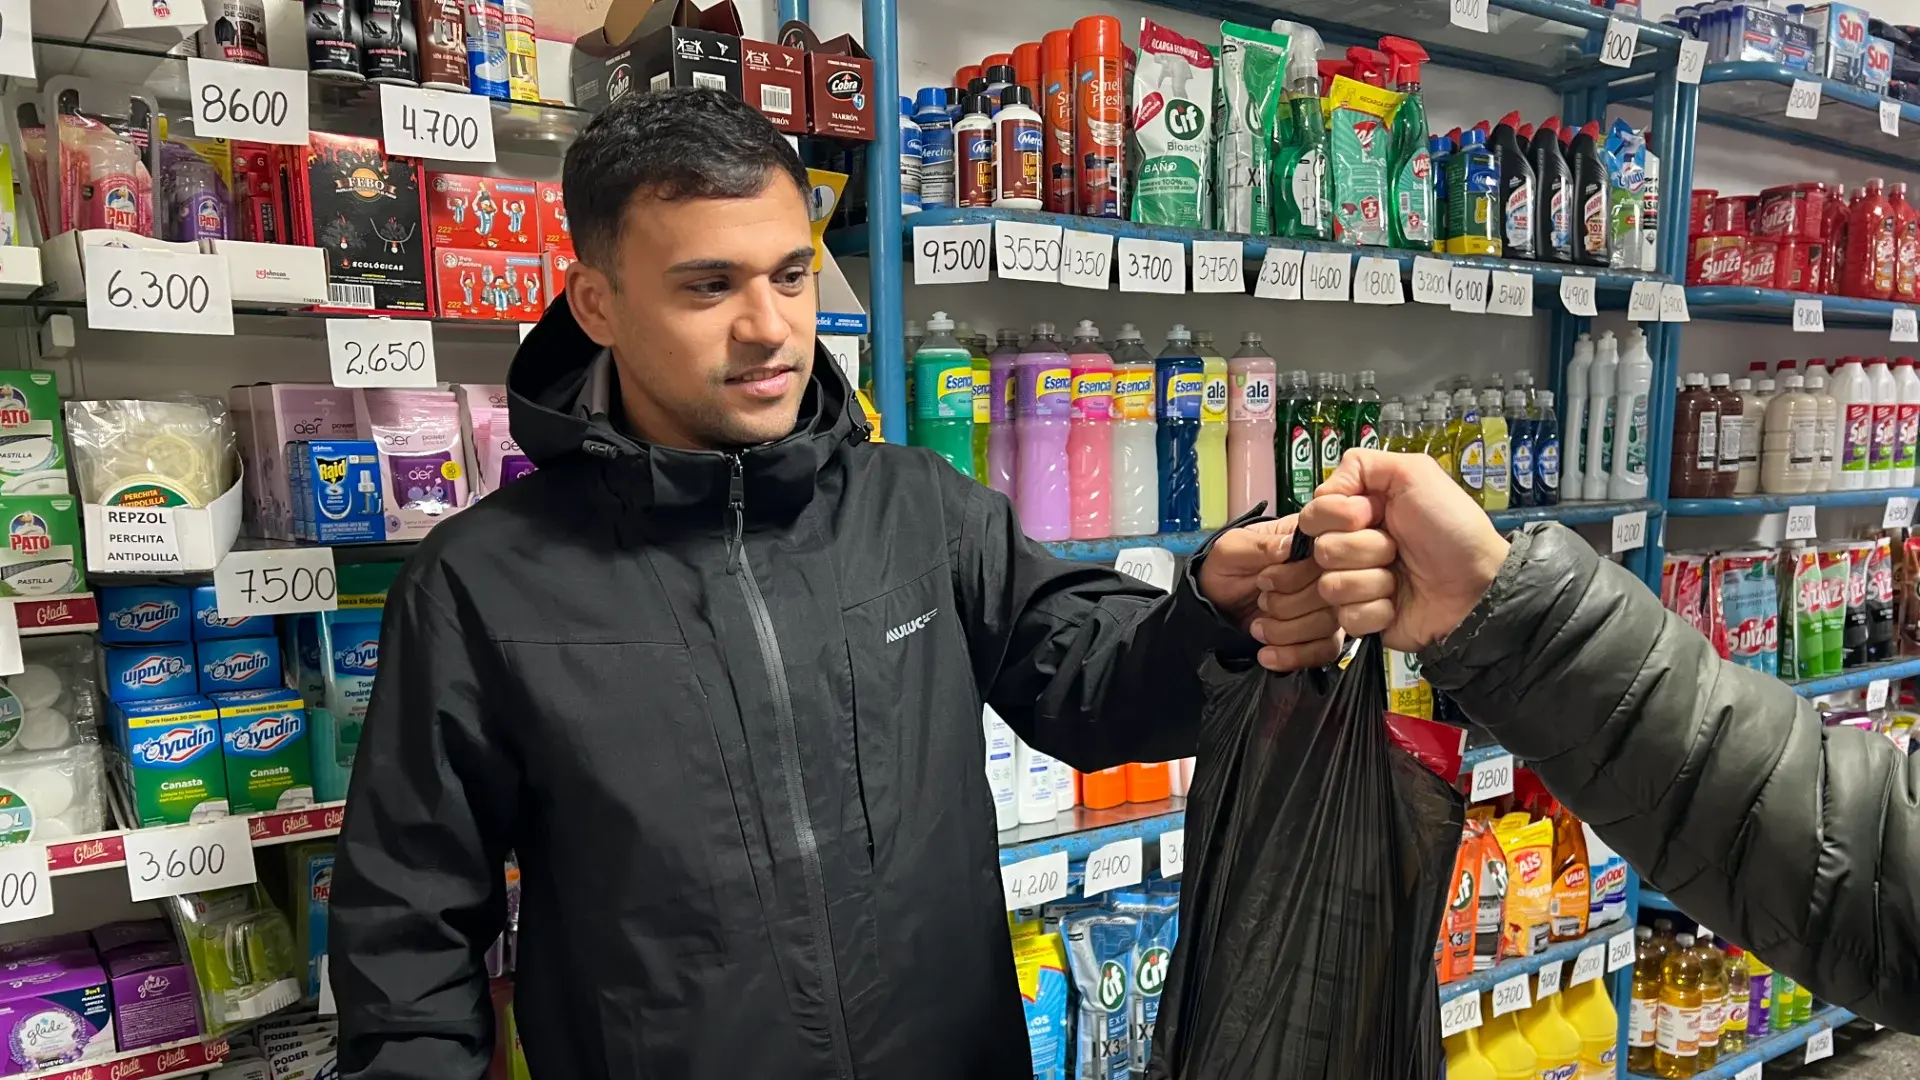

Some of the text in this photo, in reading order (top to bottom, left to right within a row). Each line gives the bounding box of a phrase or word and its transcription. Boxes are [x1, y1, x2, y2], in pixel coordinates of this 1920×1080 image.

[1838, 14, 1864, 42] Sun
[1867, 45, 1890, 71] Sun
[831, 79, 858, 91] Cobra
[402, 104, 478, 149] 4.700
[831, 112, 858, 121] MARRÓN
[1169, 104, 1198, 134] Cif
[1144, 160, 1177, 173] BAÑO
[348, 176, 384, 190] FEBO
[923, 239, 986, 274] 9.500
[1002, 234, 1062, 271] 3.550
[352, 261, 404, 271] ECOLÓGICAS
[1128, 253, 1172, 282] 3.700
[1700, 252, 1742, 279] Suiza
[107, 269, 209, 314] 6.300
[345, 341, 425, 375] 2.650
[1207, 381, 1226, 399] ala
[1247, 381, 1269, 398] ala
[422, 434, 446, 442] power
[319, 459, 346, 480] Raid
[124, 490, 158, 501] PERCHITA
[108, 512, 167, 524] REPZOL
[11, 535, 50, 550] PATO
[109, 534, 164, 544] PERCHITA
[107, 552, 179, 562] ANTIPOLILLA
[235, 567, 335, 604] 7.500
[37, 602, 73, 625] Glade
[116, 601, 181, 630] Ayudín
[209, 653, 270, 682] Ayudín
[142, 724, 215, 763] Ayudín
[232, 715, 301, 751] Ayudín
[250, 766, 290, 778] Canasta
[160, 778, 203, 791] Canasta
[282, 815, 313, 835] Glade
[324, 812, 345, 831] Glad
[73, 842, 109, 864] Glade
[139, 843, 225, 882] 3.600
[1011, 870, 1059, 899] 4.200
[138, 977, 171, 999] glade
[27, 1019, 69, 1046] glade
[257, 1019, 291, 1030] PODER
[263, 1030, 299, 1042] PODER
[267, 1041, 303, 1053] PODER
[1102, 1039, 1121, 1058] X3
[39, 1059, 64, 1068] NUEVO
[110, 1057, 145, 1080] Glade
[157, 1048, 190, 1072] Glade
[204, 1039, 230, 1062] Glad
[273, 1050, 309, 1068] PODER
[275, 1065, 290, 1075] X6
